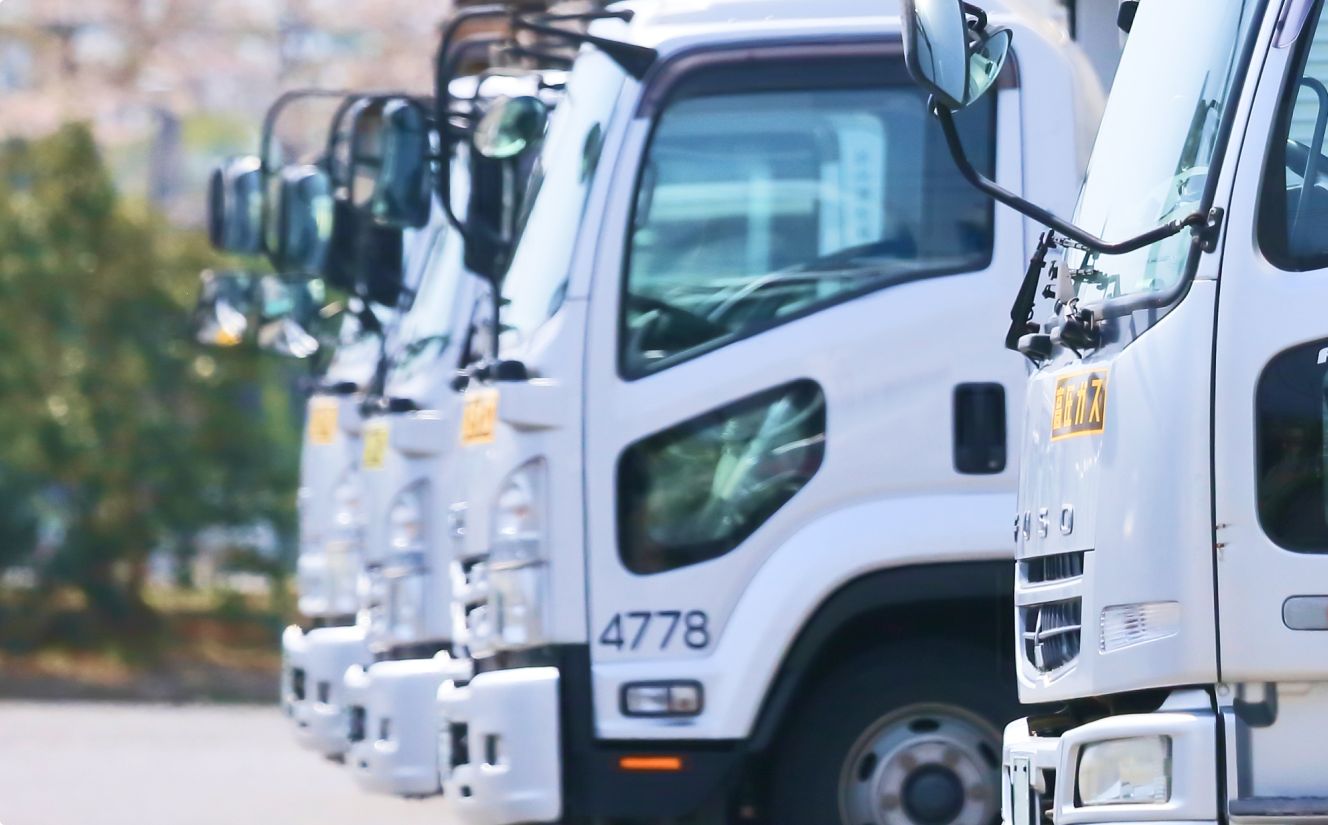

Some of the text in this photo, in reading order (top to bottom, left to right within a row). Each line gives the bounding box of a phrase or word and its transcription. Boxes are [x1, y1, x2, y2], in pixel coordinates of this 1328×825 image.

[1053, 379, 1104, 430] 高圧ガス
[598, 609, 711, 651] 4778
